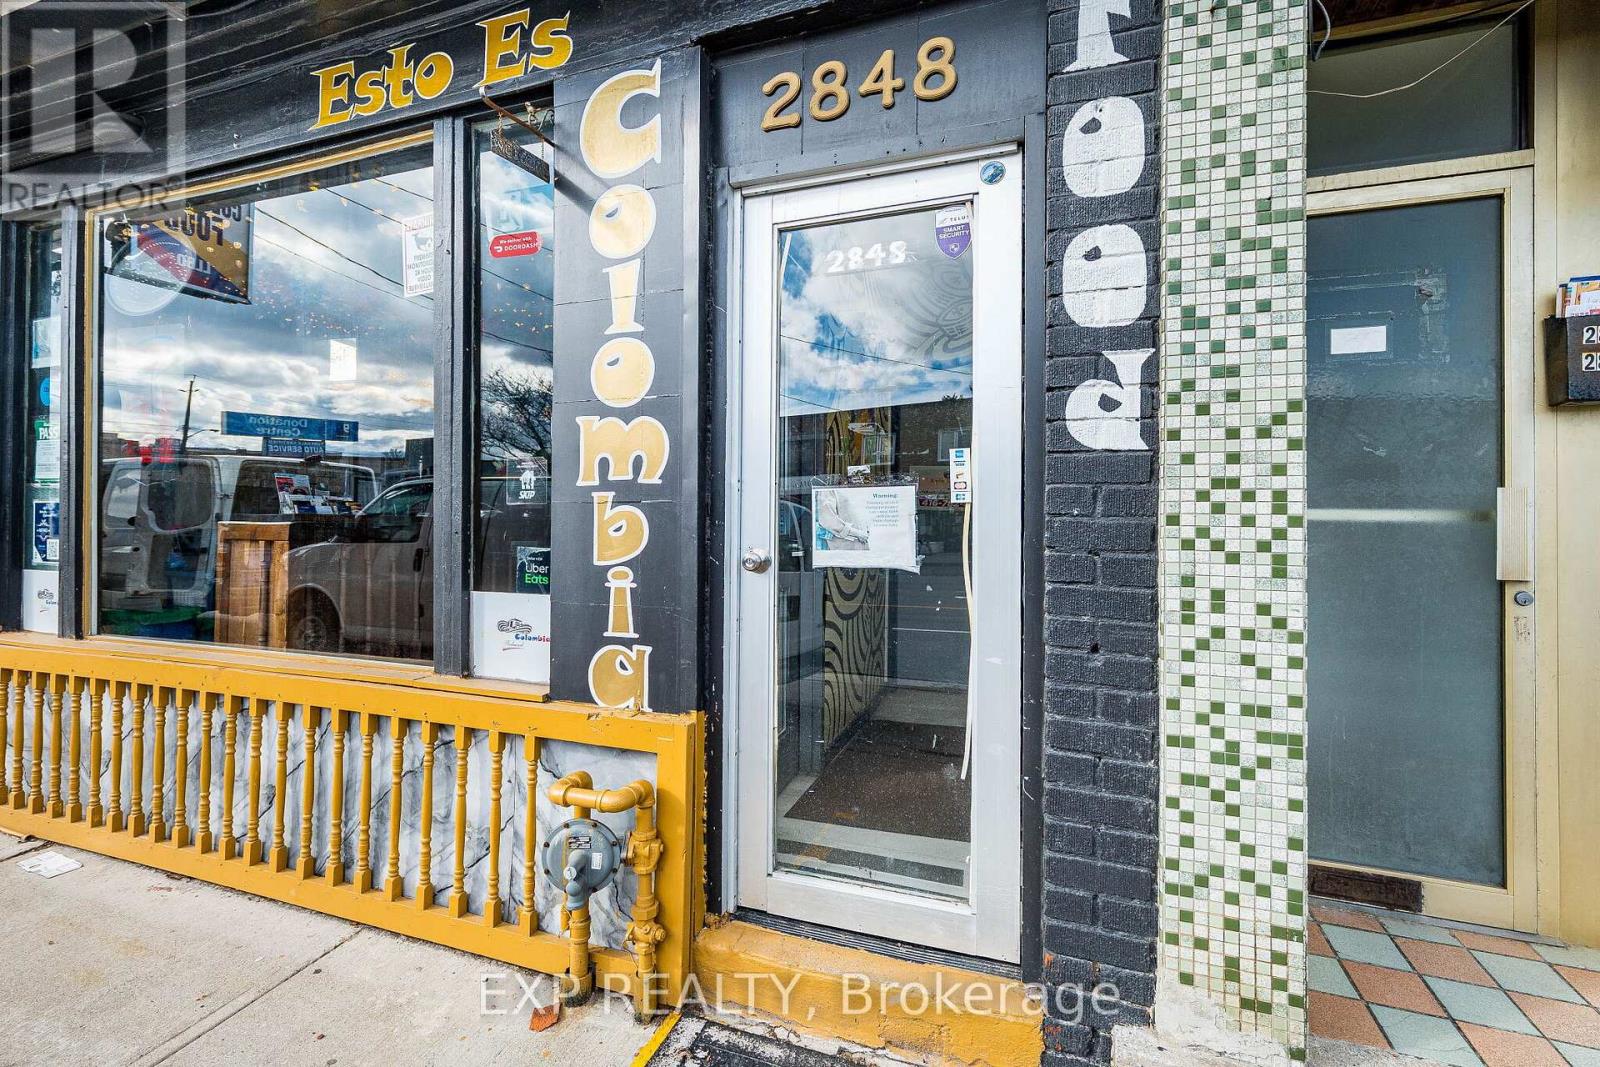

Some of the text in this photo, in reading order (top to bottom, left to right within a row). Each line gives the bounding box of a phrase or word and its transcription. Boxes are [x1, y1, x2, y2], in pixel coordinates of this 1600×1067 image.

[309, 7, 574, 131] Esto Es
[761, 36, 959, 133] 2848
[938, 230, 970, 240] SECURITY
[943, 225, 966, 233] SMART
[504, 242, 538, 251] DOORDASH
[824, 240, 907, 273] 2848
[1585, 326, 1600, 344] 2
[1585, 353, 1600, 371] 2
[575, 58, 670, 713] Colombia
[518, 490, 536, 500] SKIP
[525, 563, 549, 574] Uber
[525, 573, 549, 585] Eats
